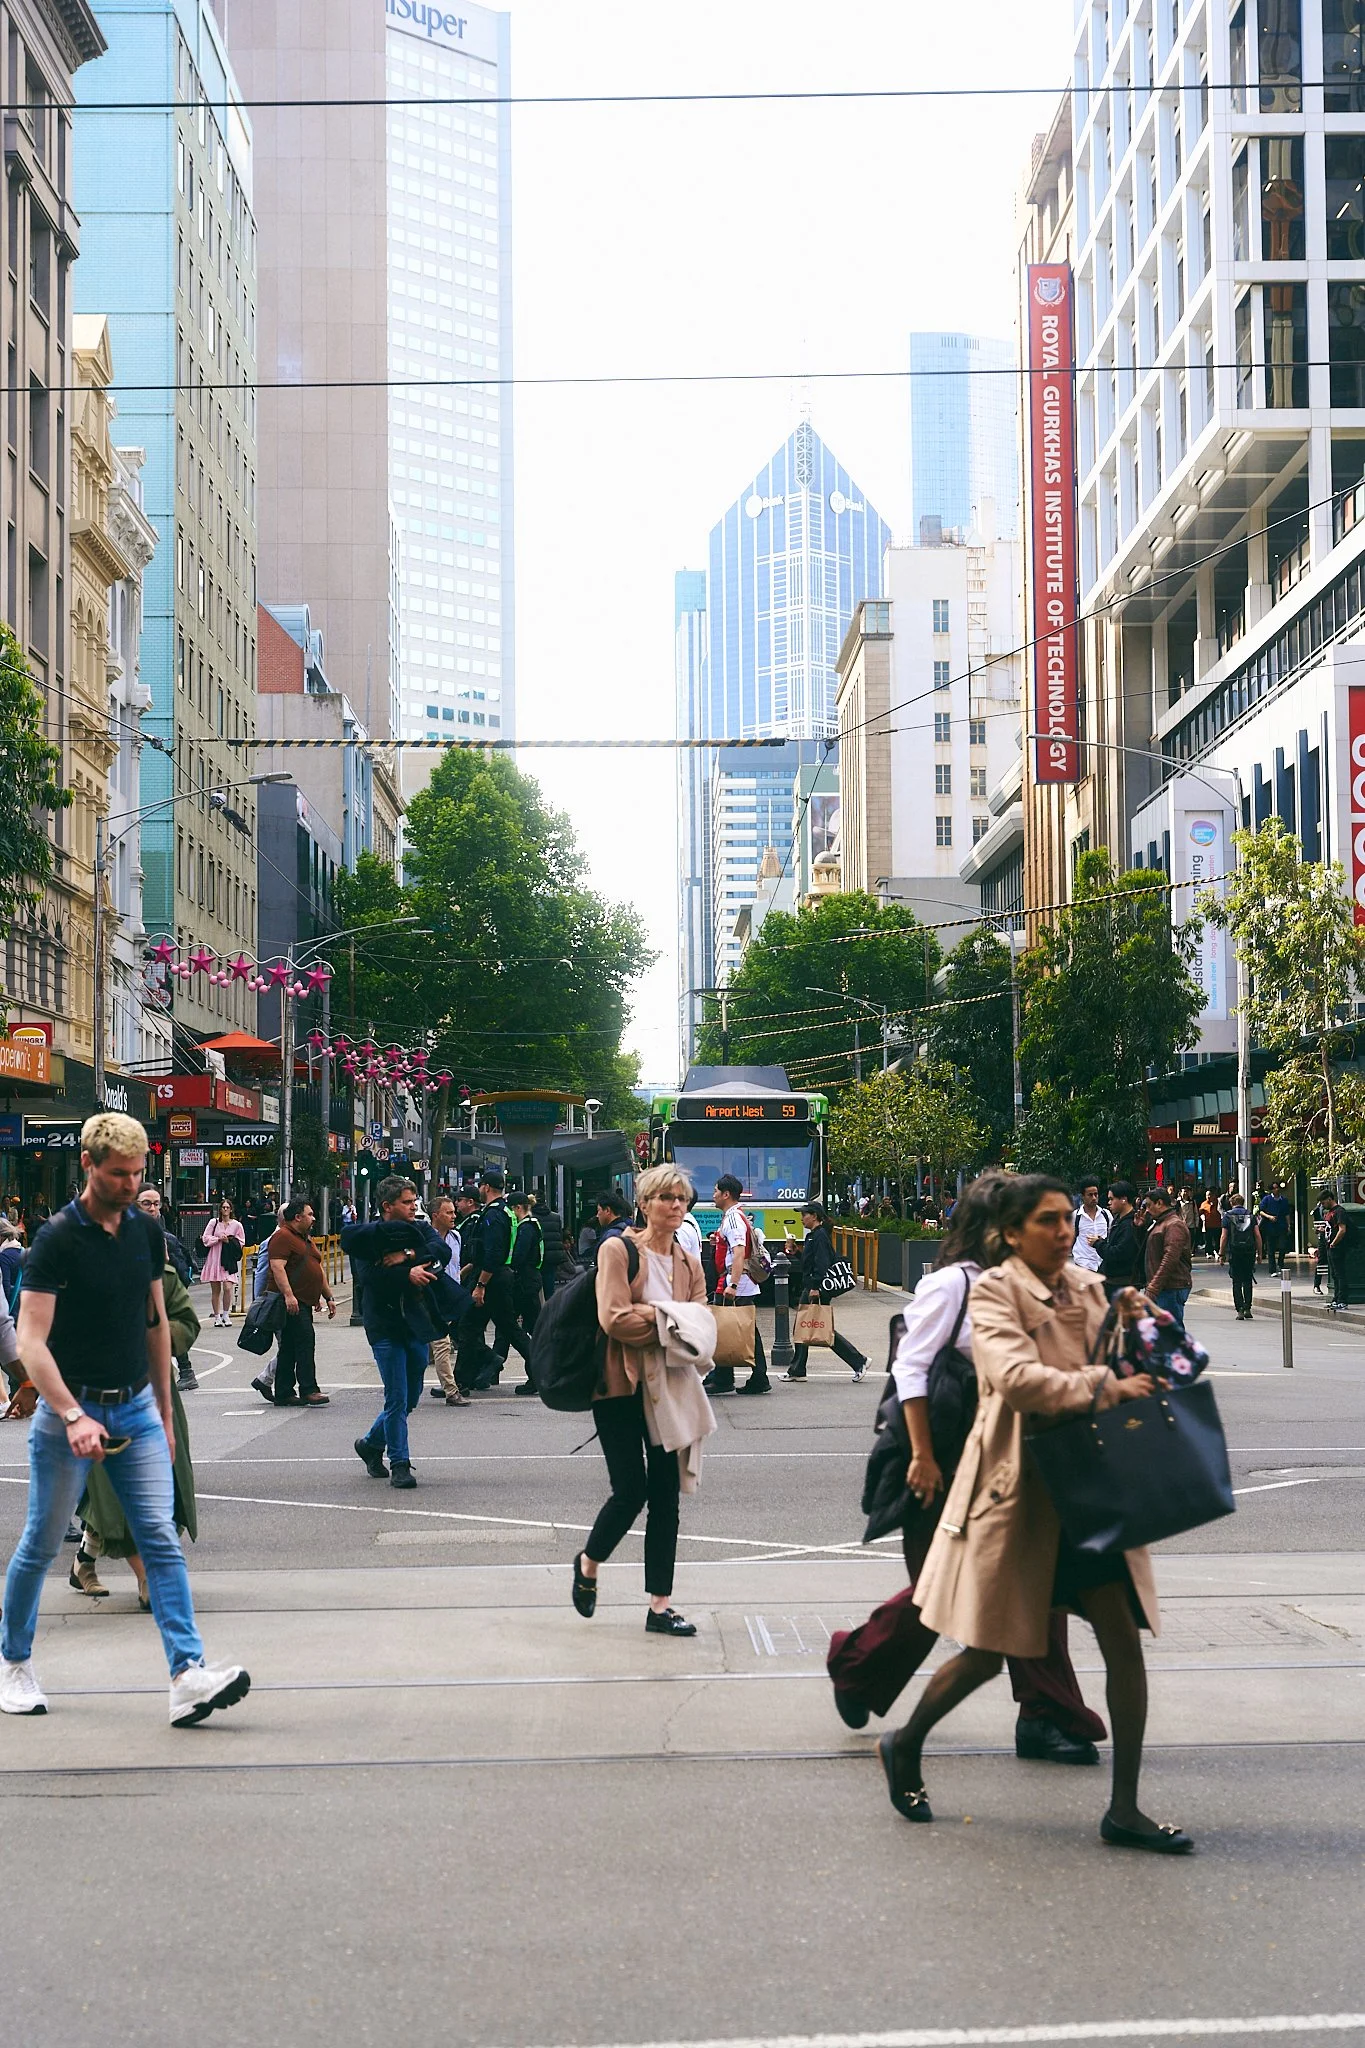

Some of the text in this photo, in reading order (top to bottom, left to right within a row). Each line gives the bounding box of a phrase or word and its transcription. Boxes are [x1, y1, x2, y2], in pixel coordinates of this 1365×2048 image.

[1041, 315, 1066, 772] ROYAL GURKHAS INSTITUTE OF TECHNOLOGY
[705, 1105, 796, 1117] Airport West 59
[373, 1124, 380, 1133] P
[47, 1133, 76, 1147] 24
[777, 1188, 806, 1199] 2065
[800, 1319, 825, 1329] coles
